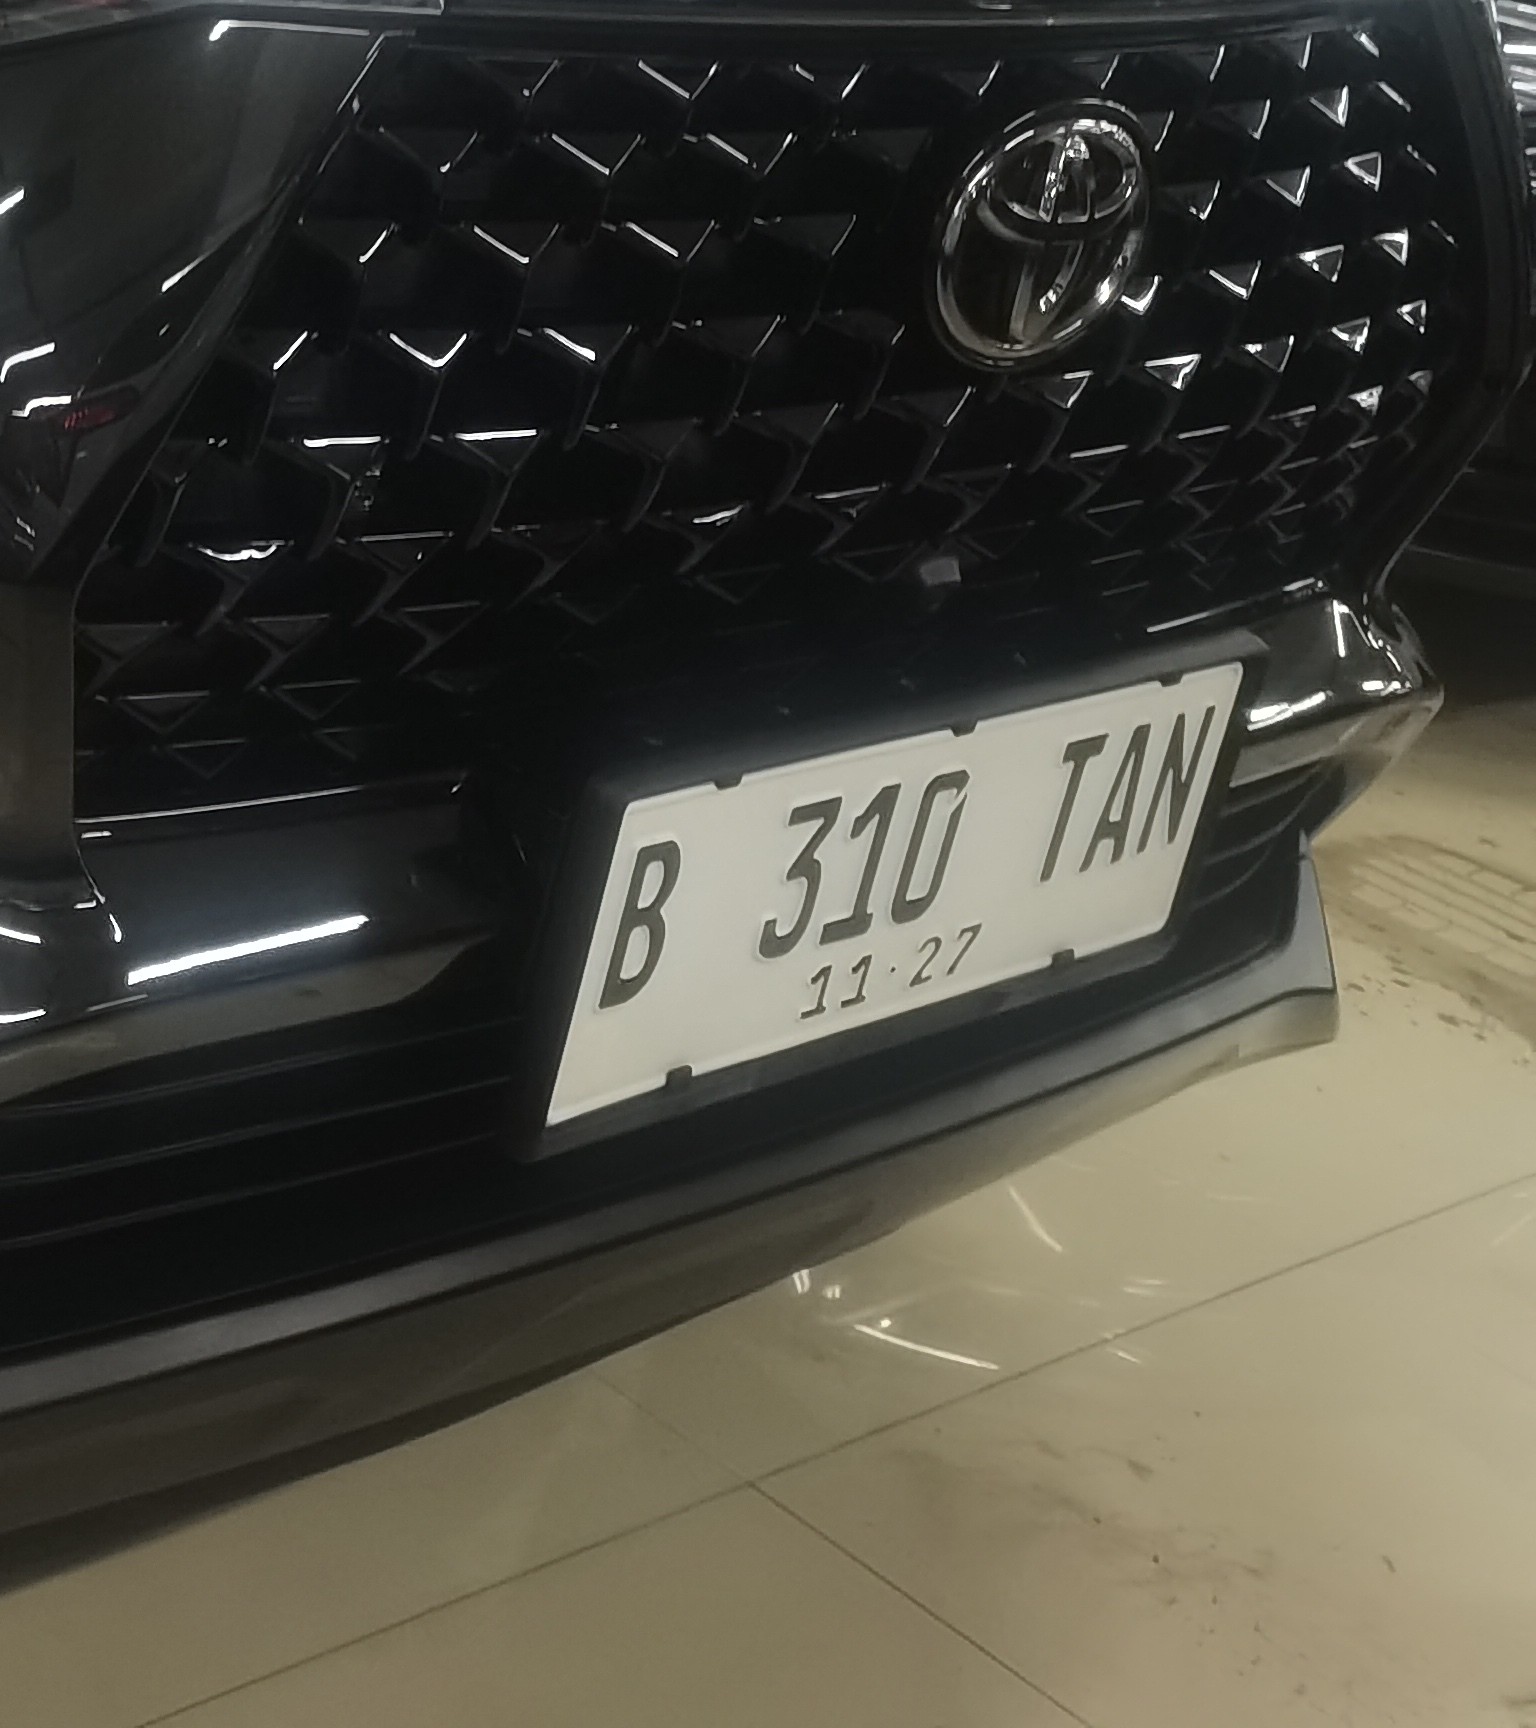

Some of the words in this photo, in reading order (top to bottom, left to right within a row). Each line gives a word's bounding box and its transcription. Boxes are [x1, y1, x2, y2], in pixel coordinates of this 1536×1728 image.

[597, 839, 682, 1010] B
[757, 768, 970, 959] 310
[1038, 705, 1216, 883] TAN
